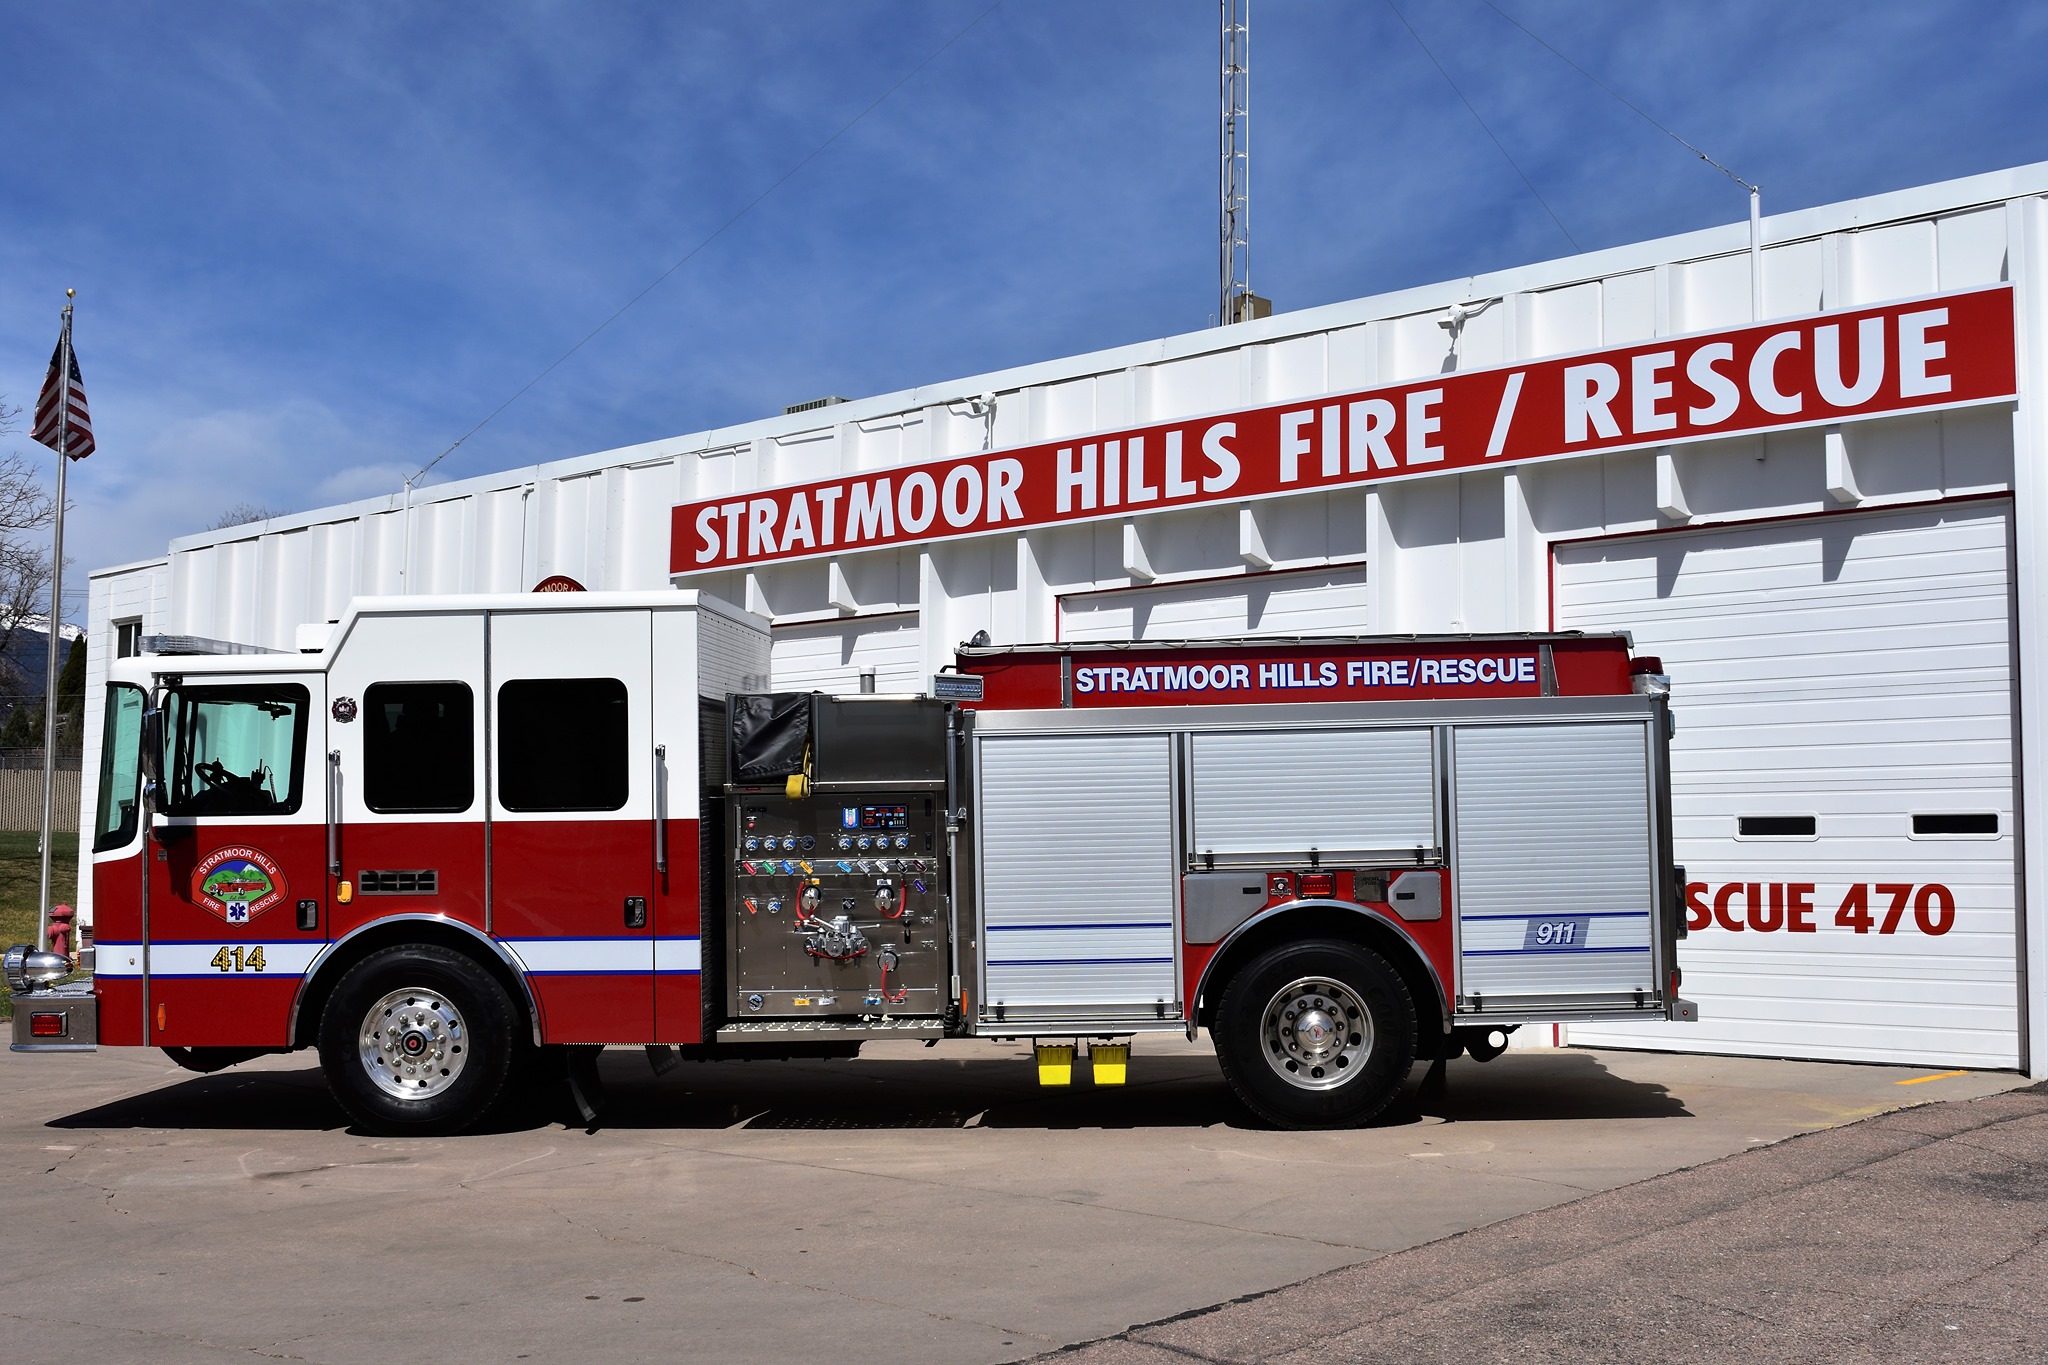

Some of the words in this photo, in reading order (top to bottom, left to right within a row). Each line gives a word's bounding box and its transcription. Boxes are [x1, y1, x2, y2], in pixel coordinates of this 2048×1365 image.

[695, 457, 1025, 565] STRATMOOR
[1056, 420, 1241, 514] HILLS
[1279, 387, 1445, 483] FIRE
[1485, 371, 1526, 458] /
[1563, 306, 1953, 444] RESCUE
[1075, 664, 1250, 693] STRATMOOR
[1259, 661, 1338, 689] HILLS
[1347, 657, 1537, 687] FIRE/RESCUE
[199, 848, 253, 875] STRATMOOR
[253, 853, 277, 875] HILLS
[202, 897, 221, 911] FIRE
[249, 893, 280, 913] RESCUE
[1685, 882, 1817, 933] SCUE
[1834, 883, 1956, 936] 470
[1536, 921, 1577, 945] 911
[211, 945, 266, 972] 414
